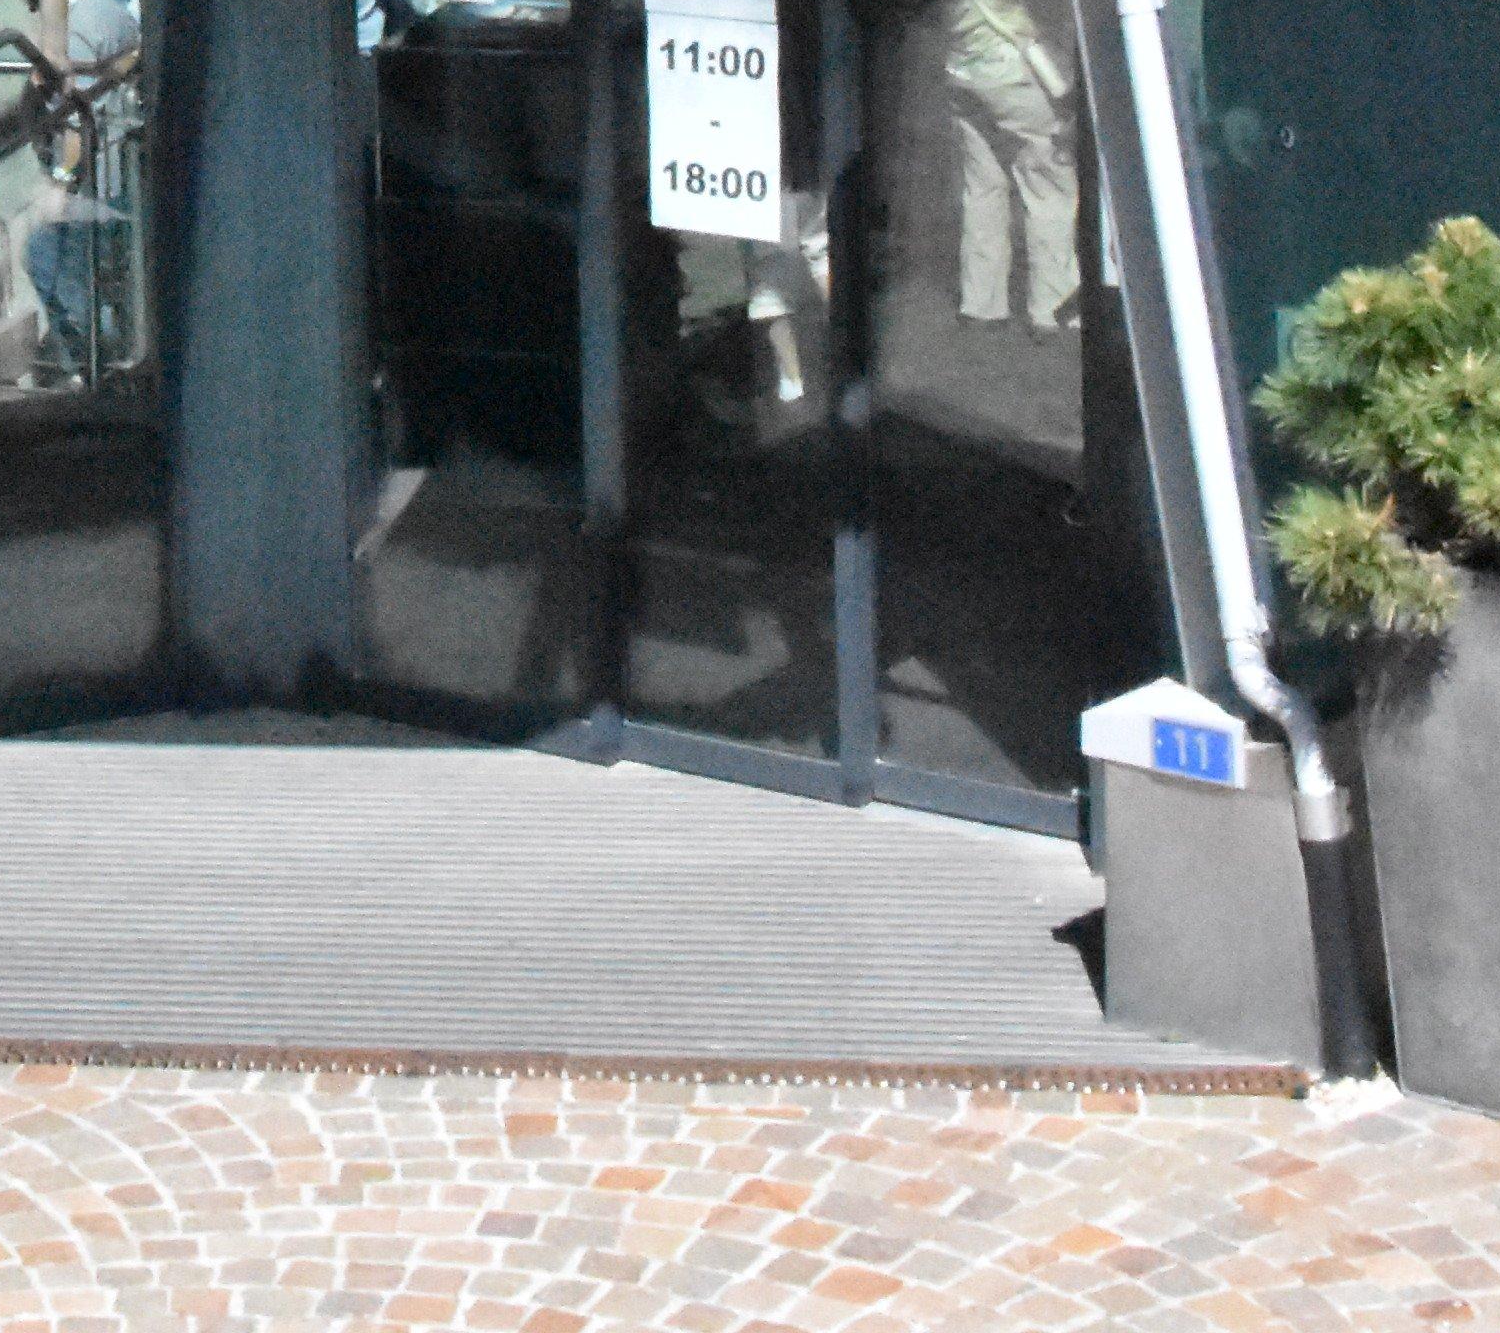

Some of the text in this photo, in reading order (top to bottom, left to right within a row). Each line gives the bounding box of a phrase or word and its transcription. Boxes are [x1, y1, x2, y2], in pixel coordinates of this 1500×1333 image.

[659, 38, 766, 81] 11:00
[662, 158, 768, 203] 18:00
[1174, 728, 1211, 771] 11
